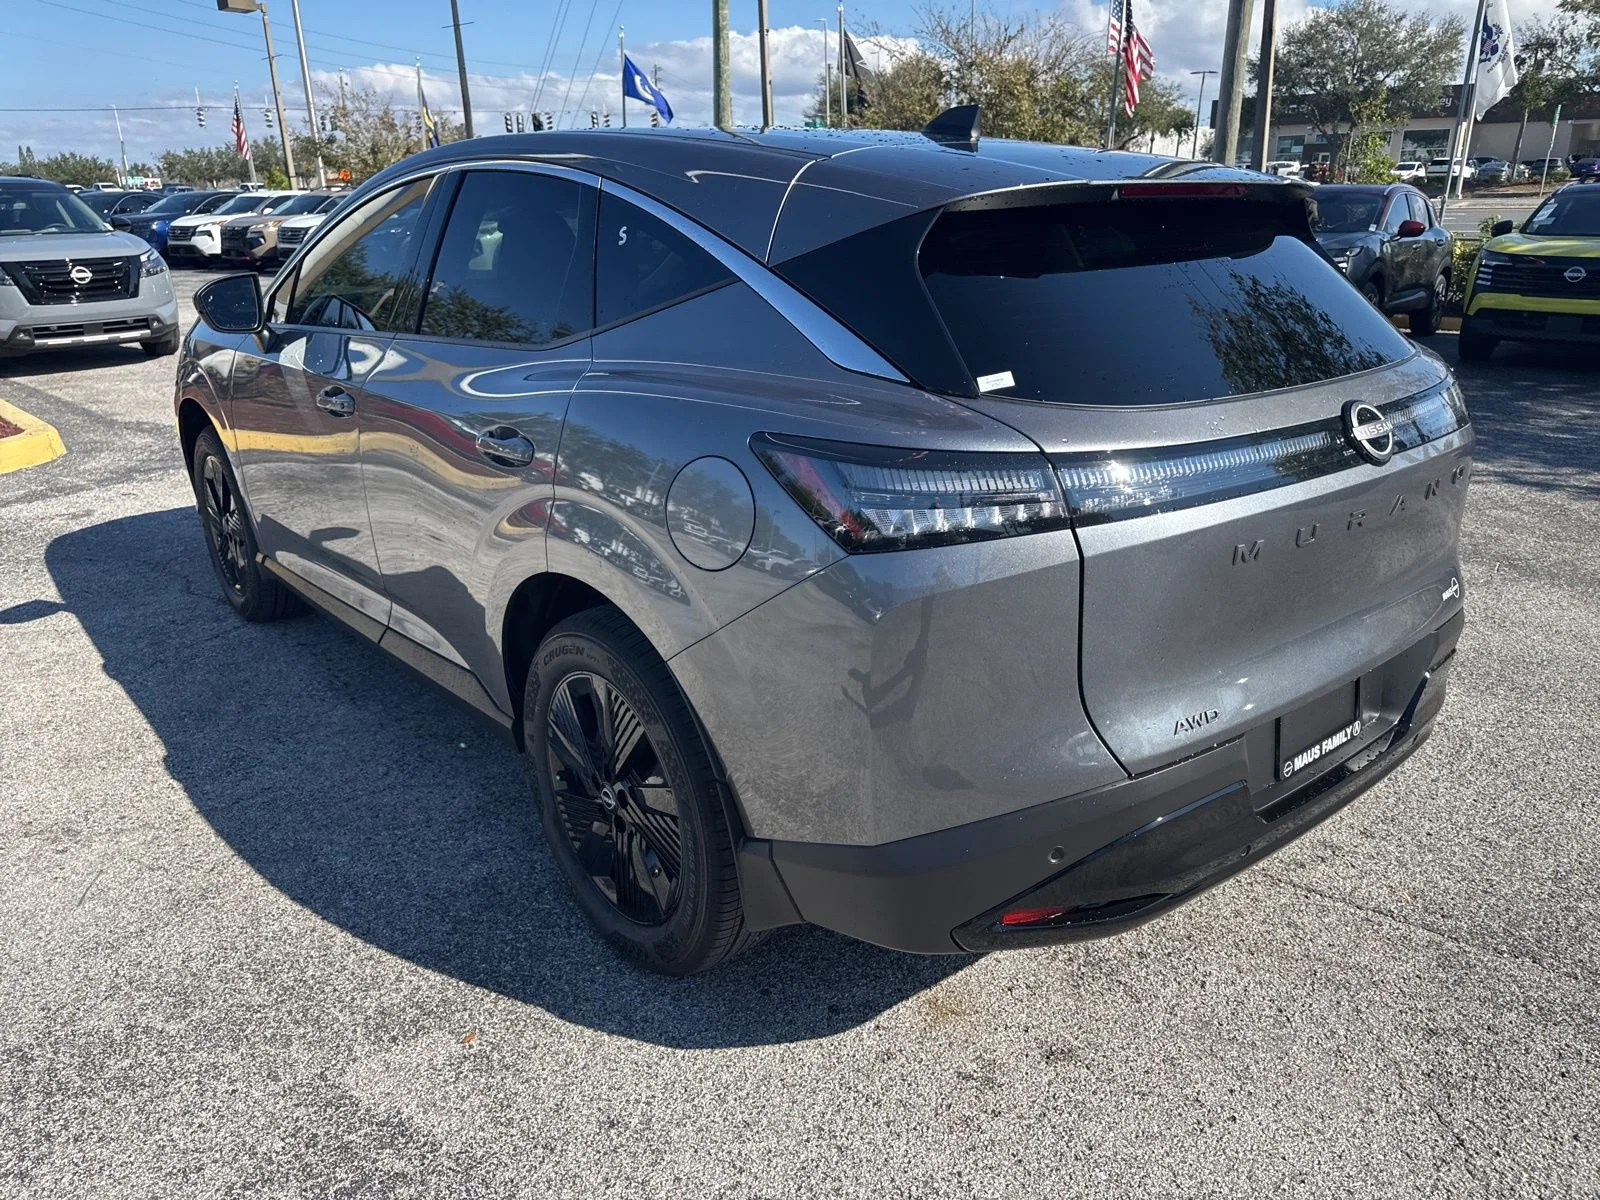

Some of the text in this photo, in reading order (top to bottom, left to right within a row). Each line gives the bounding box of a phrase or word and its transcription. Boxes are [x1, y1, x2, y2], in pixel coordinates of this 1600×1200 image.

[1232, 465, 1463, 566] MURANO
[1173, 709, 1219, 736] AWD
[1294, 725, 1353, 771] MAUS FAMILY
